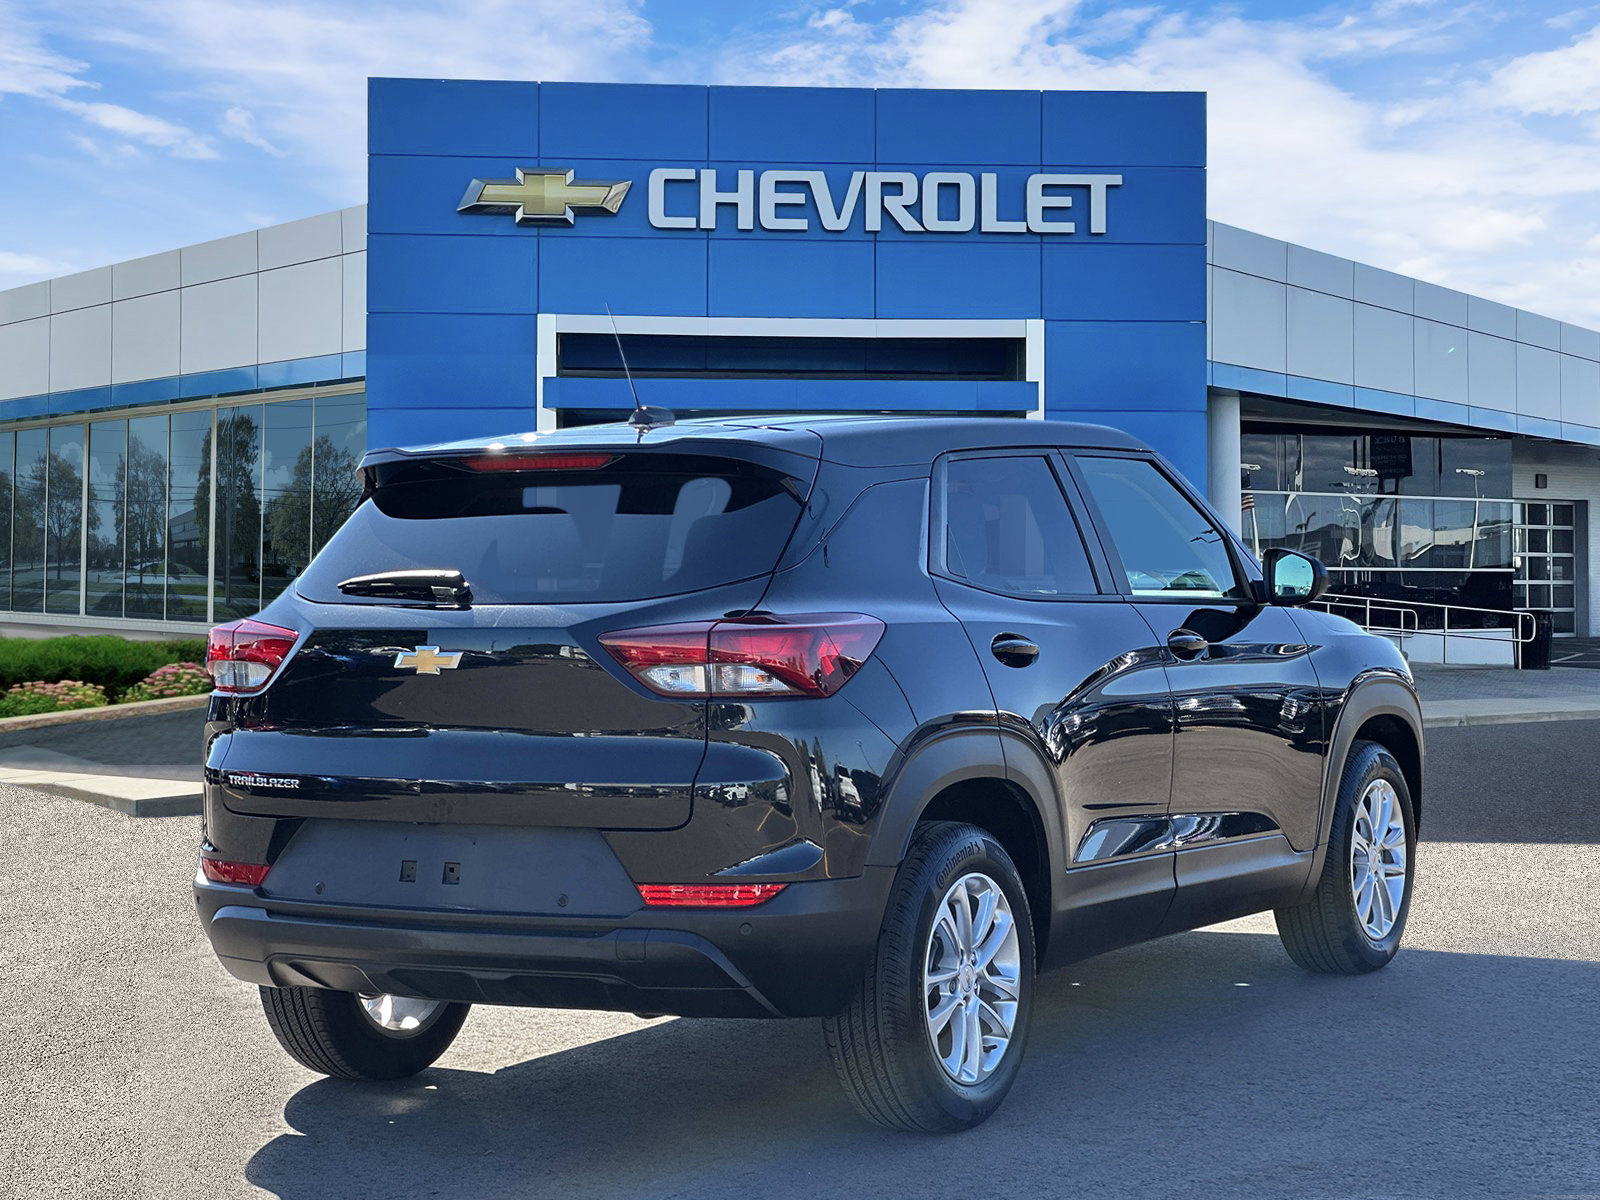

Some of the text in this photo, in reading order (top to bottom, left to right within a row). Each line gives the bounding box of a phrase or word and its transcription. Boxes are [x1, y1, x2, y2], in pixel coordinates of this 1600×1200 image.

[648, 167, 1122, 234] CHEVROLET
[228, 775, 300, 789] TRAILBLAZER
[936, 841, 975, 890] Continental
